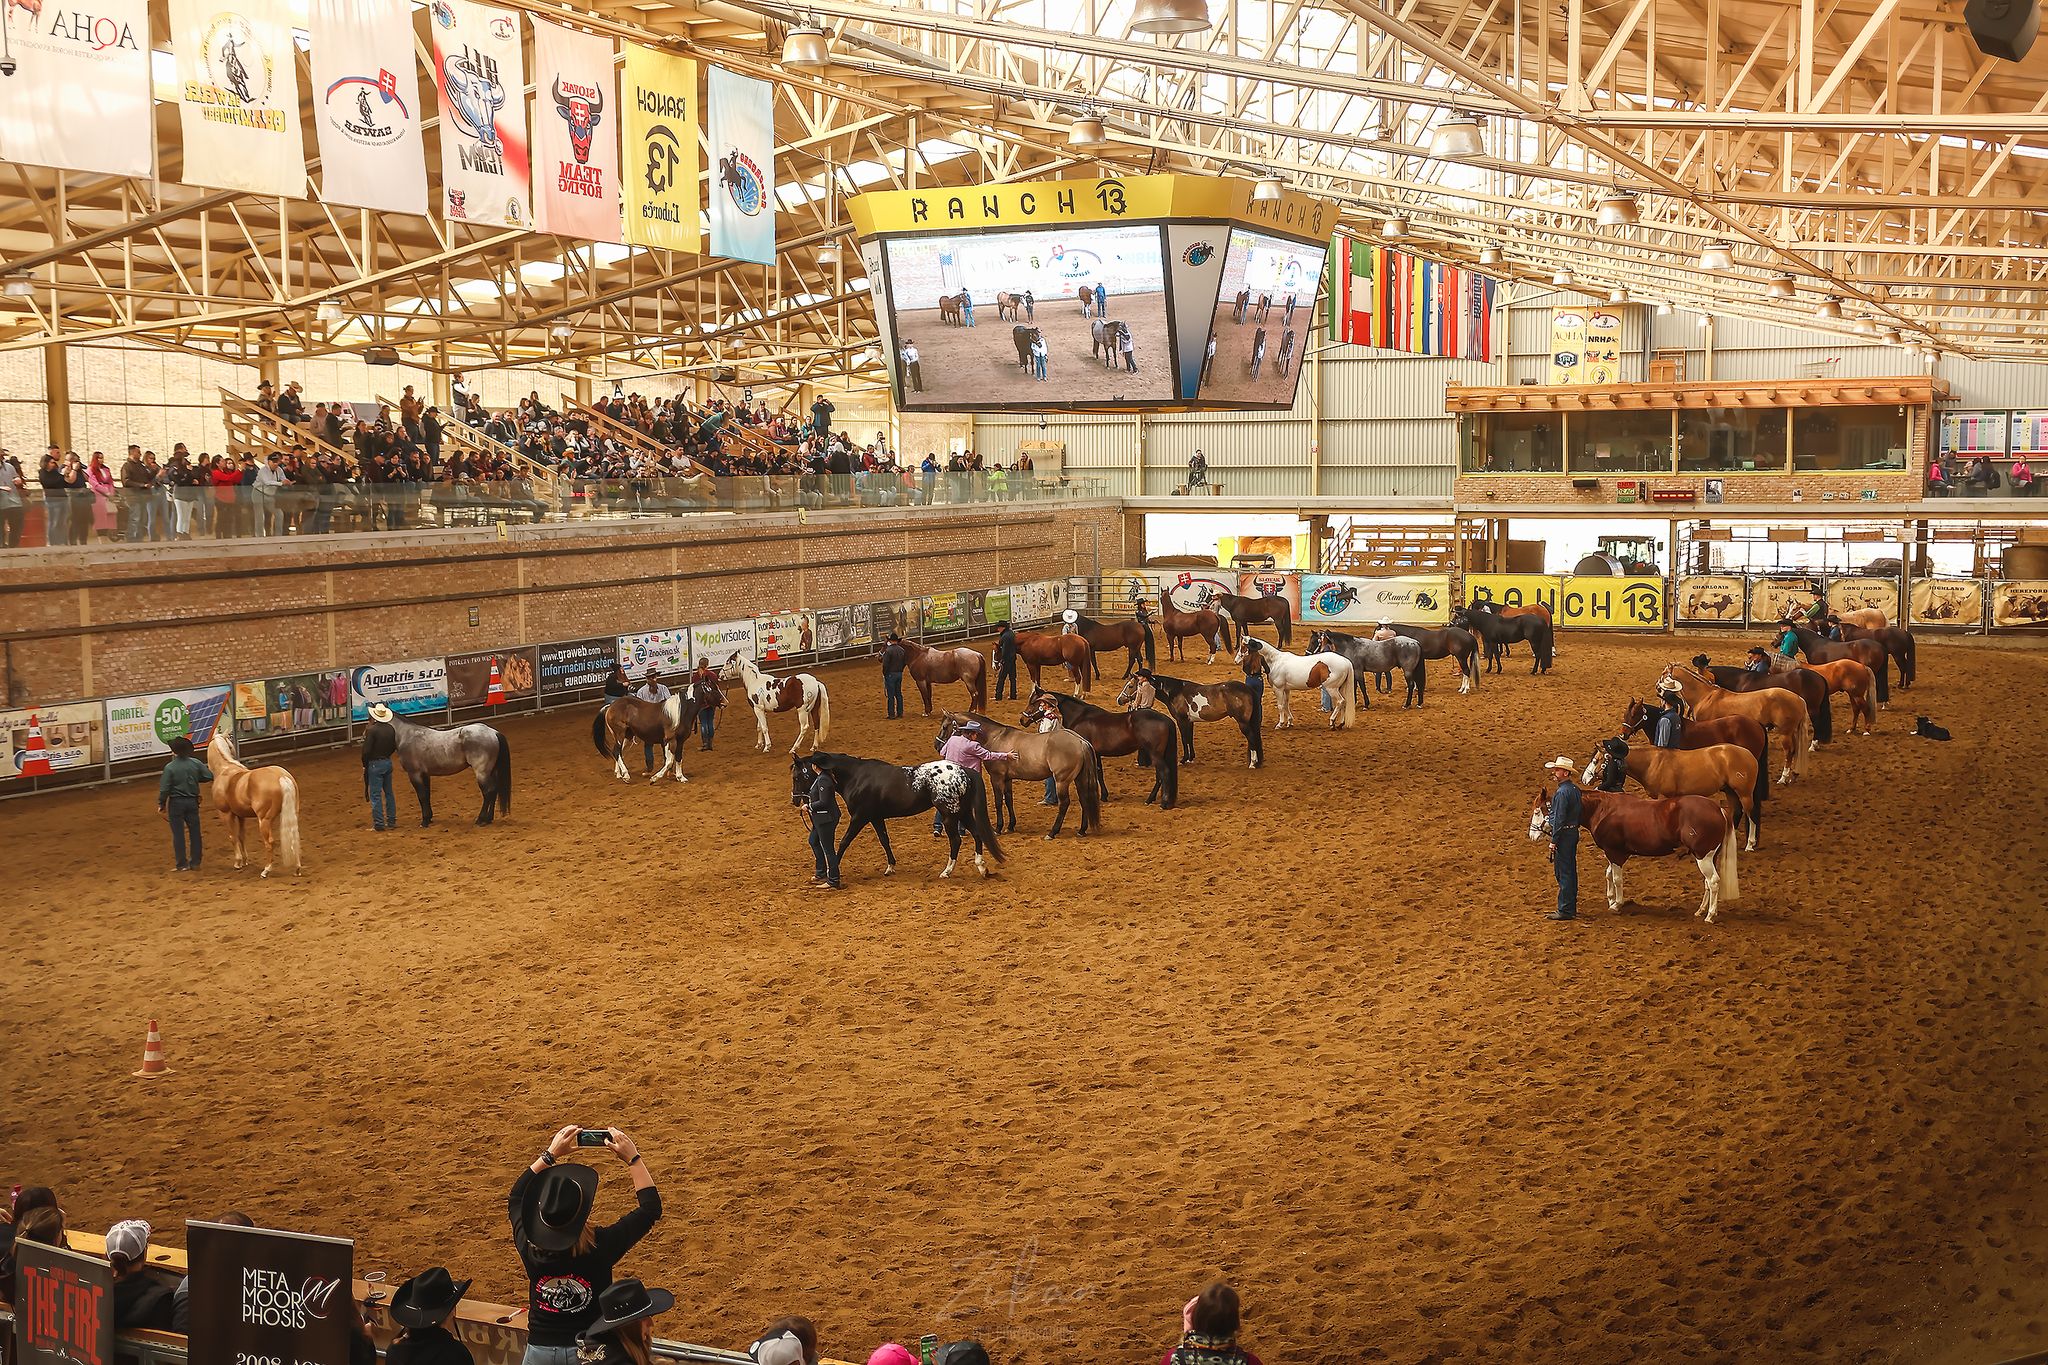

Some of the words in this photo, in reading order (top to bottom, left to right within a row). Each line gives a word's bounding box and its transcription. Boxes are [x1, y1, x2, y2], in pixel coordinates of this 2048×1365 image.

[912, 188, 1076, 223] RANCH
[1097, 188, 1127, 215] 13
[1376, 589, 1412, 604] Ranch
[1623, 593, 1660, 624] 13
[541, 645, 601, 662] www.graweb.com
[364, 669, 414, 687] Aquatris
[419, 668, 447, 680] s.r.o.
[542, 659, 586, 677] informační
[112, 706, 144, 721] MARTEL
[156, 705, 189, 725] -50%
[112, 721, 151, 735] UŠETRITE
[242, 1267, 289, 1291] META
[242, 1286, 301, 1311] MOOR
[24, 1266, 59, 1343] THE
[64, 1283, 104, 1365] FIRE
[242, 1304, 306, 1329] PHOSIS
